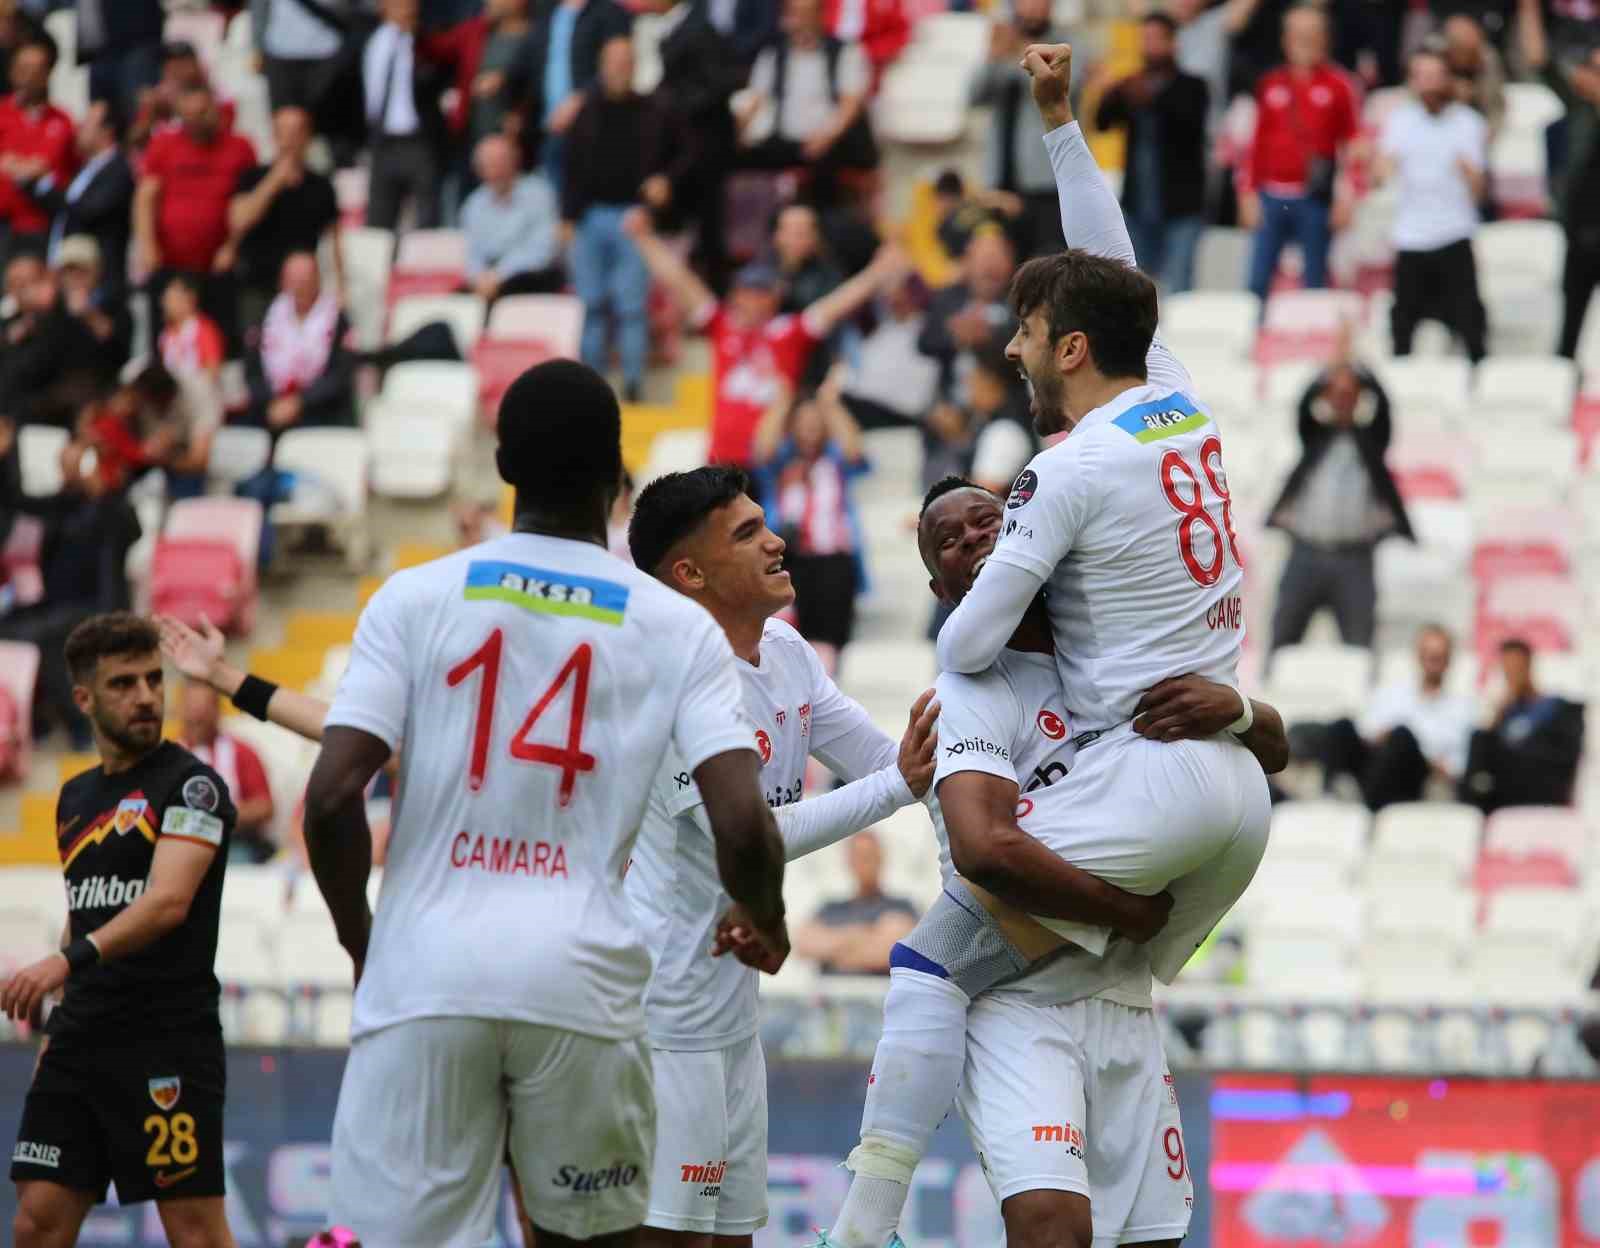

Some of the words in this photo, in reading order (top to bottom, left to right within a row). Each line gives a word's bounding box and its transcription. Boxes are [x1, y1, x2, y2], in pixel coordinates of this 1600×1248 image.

[1142, 408, 1187, 431] aksa
[499, 571, 594, 605] aksa
[446, 626, 597, 808] 14
[966, 737, 1009, 760] bitexe
[450, 830, 569, 880] CAMARA
[66, 873, 150, 911] istikba
[143, 1111, 199, 1166] 28
[680, 1159, 729, 1184] misli
